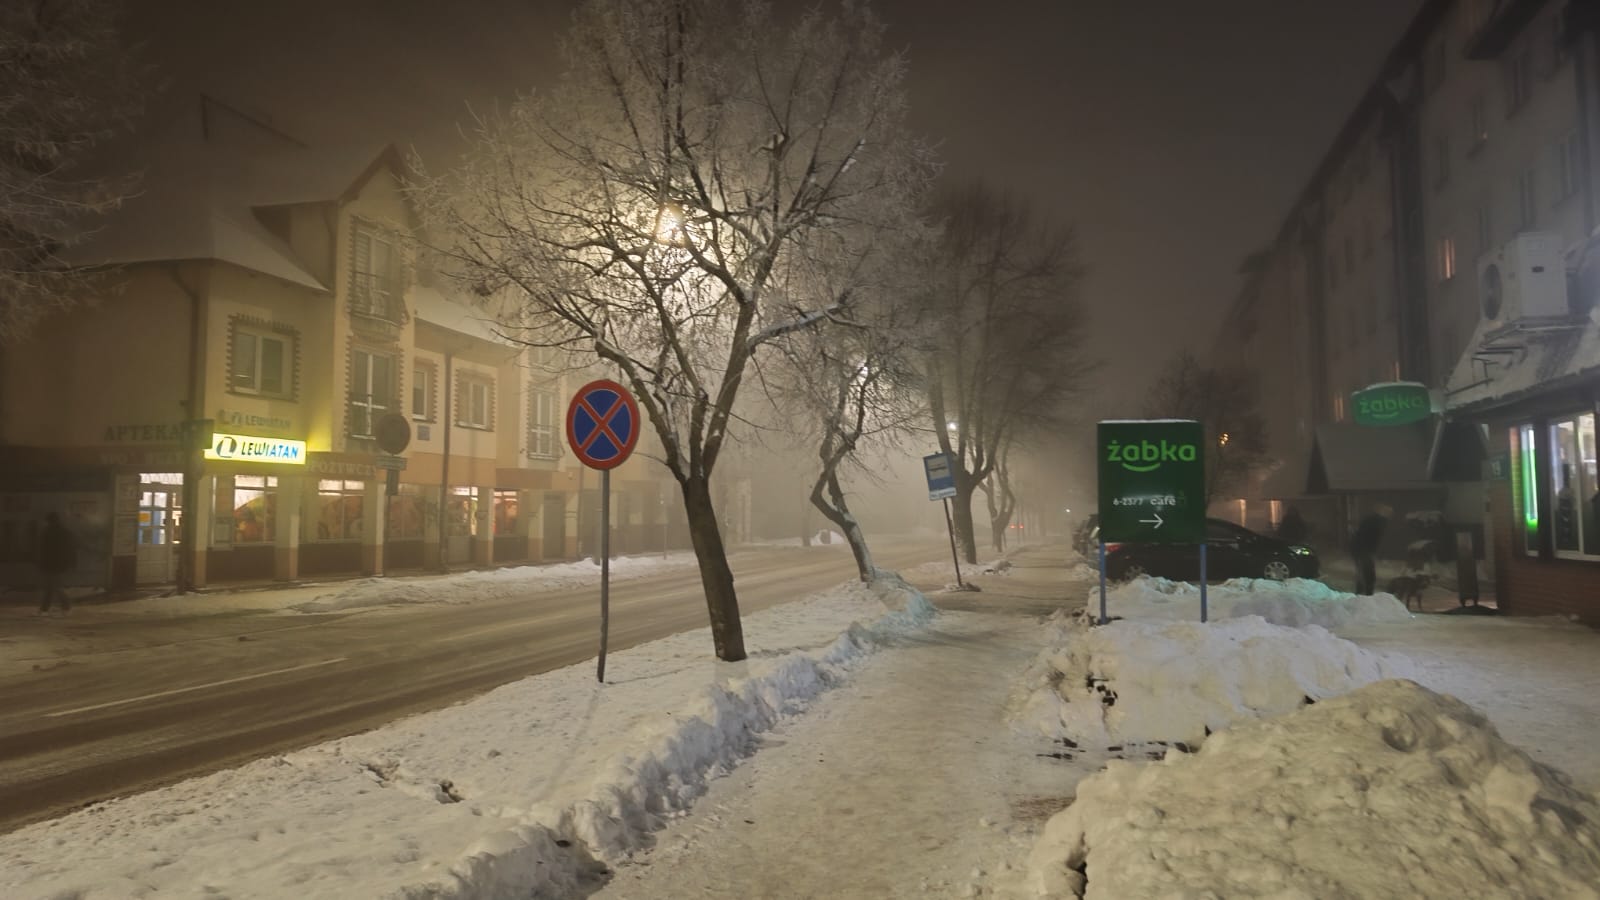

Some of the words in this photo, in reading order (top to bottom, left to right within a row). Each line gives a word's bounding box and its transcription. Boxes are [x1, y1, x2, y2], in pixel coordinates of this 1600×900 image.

[104, 424, 183, 441] APTEKA
[240, 440, 299, 459] LEWIATAN
[1107, 440, 1197, 461] żabka
